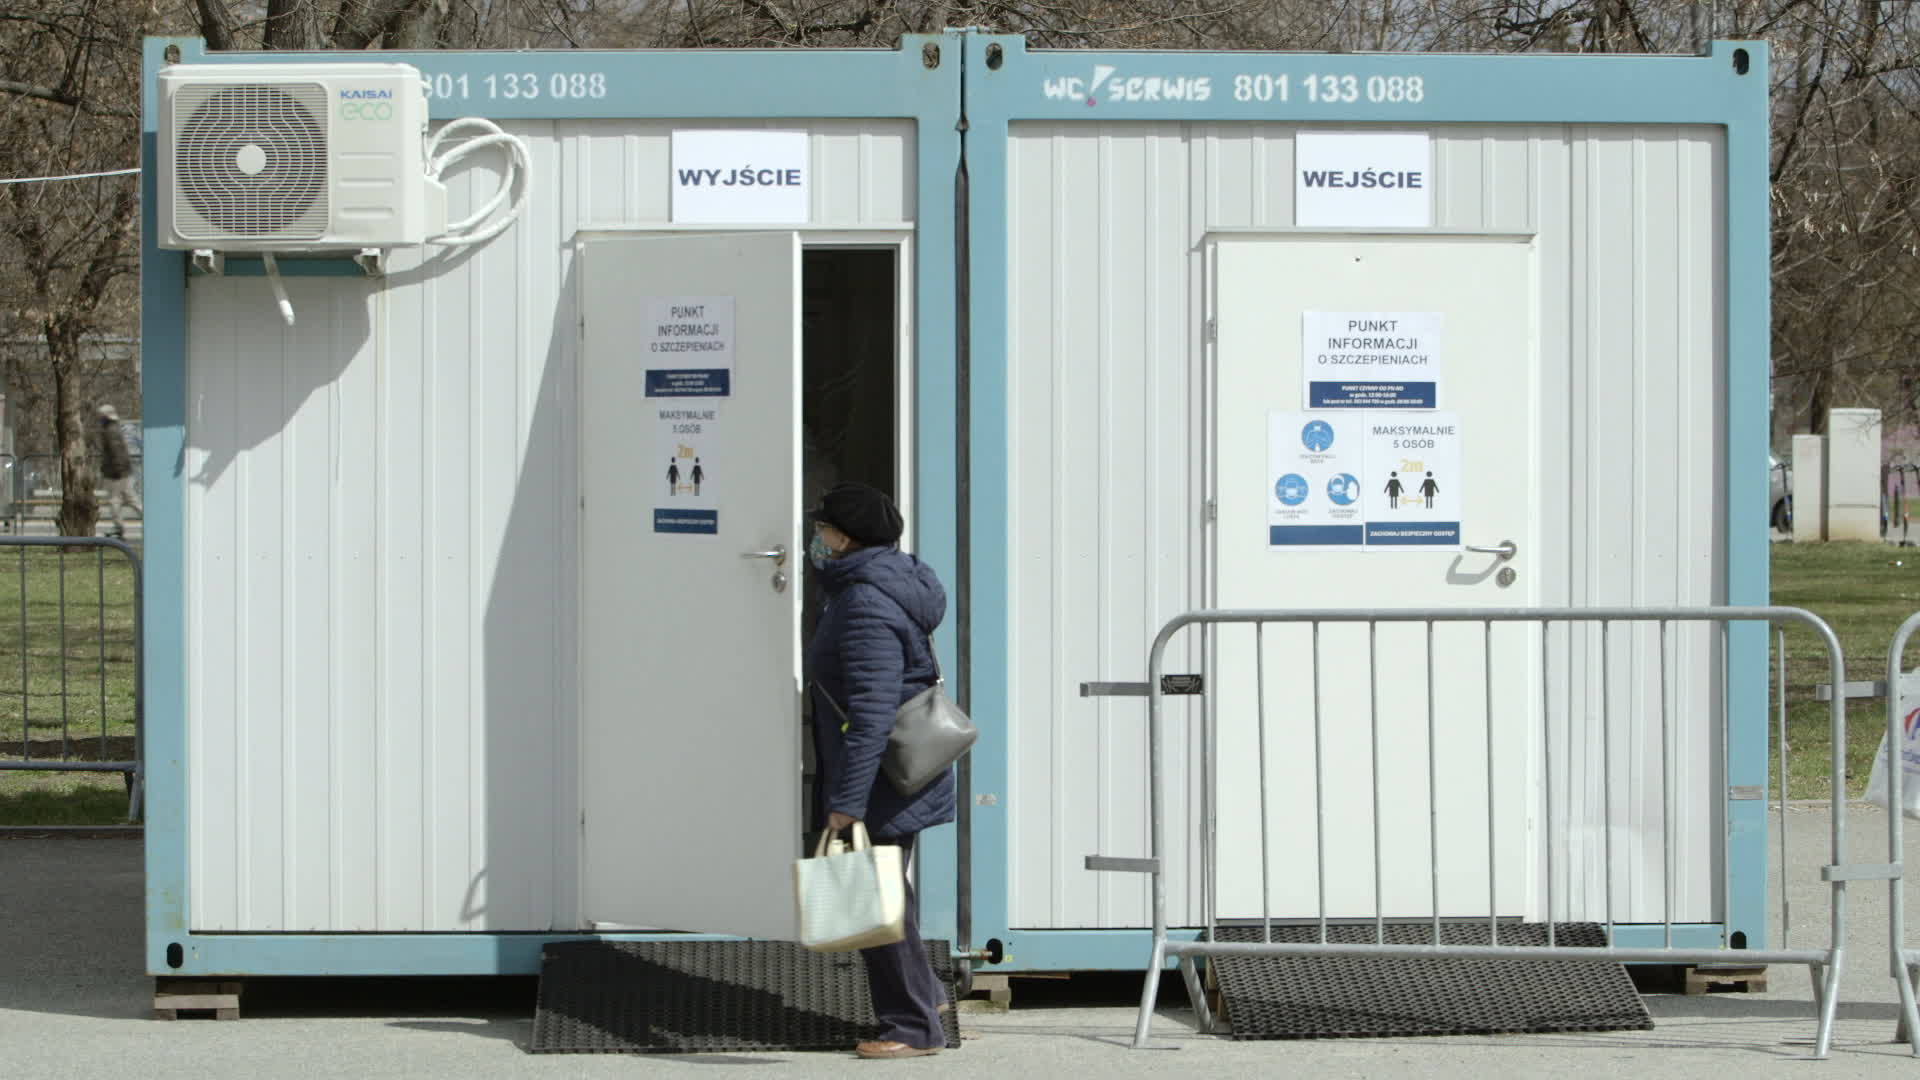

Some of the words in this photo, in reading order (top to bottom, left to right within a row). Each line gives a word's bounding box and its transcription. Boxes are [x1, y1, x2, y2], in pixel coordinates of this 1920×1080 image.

[484, 73, 539, 99] 133
[549, 73, 607, 99] 088
[1233, 74, 1289, 103] 801
[1302, 74, 1359, 103] 133
[1366, 75, 1424, 104] 088
[340, 89, 393, 99] KAISAI
[678, 164, 801, 187] WYJŚCIE
[1303, 167, 1423, 189] WEJŚCIE
[671, 306, 705, 318] PUNKT
[657, 324, 719, 336] INFORMACJI
[1348, 320, 1398, 332] PUNKT
[651, 343, 658, 353] O
[660, 341, 725, 352] SZCZEPIENIACH
[1328, 338, 1418, 350] INFORMACJI
[1318, 355, 1328, 365] O
[1331, 354, 1428, 365] SZCZEPIENIACH
[1372, 426, 1455, 436] MAKSYMALNIE
[1393, 440, 1399, 449] 5
[1400, 459, 1424, 473] 2m
